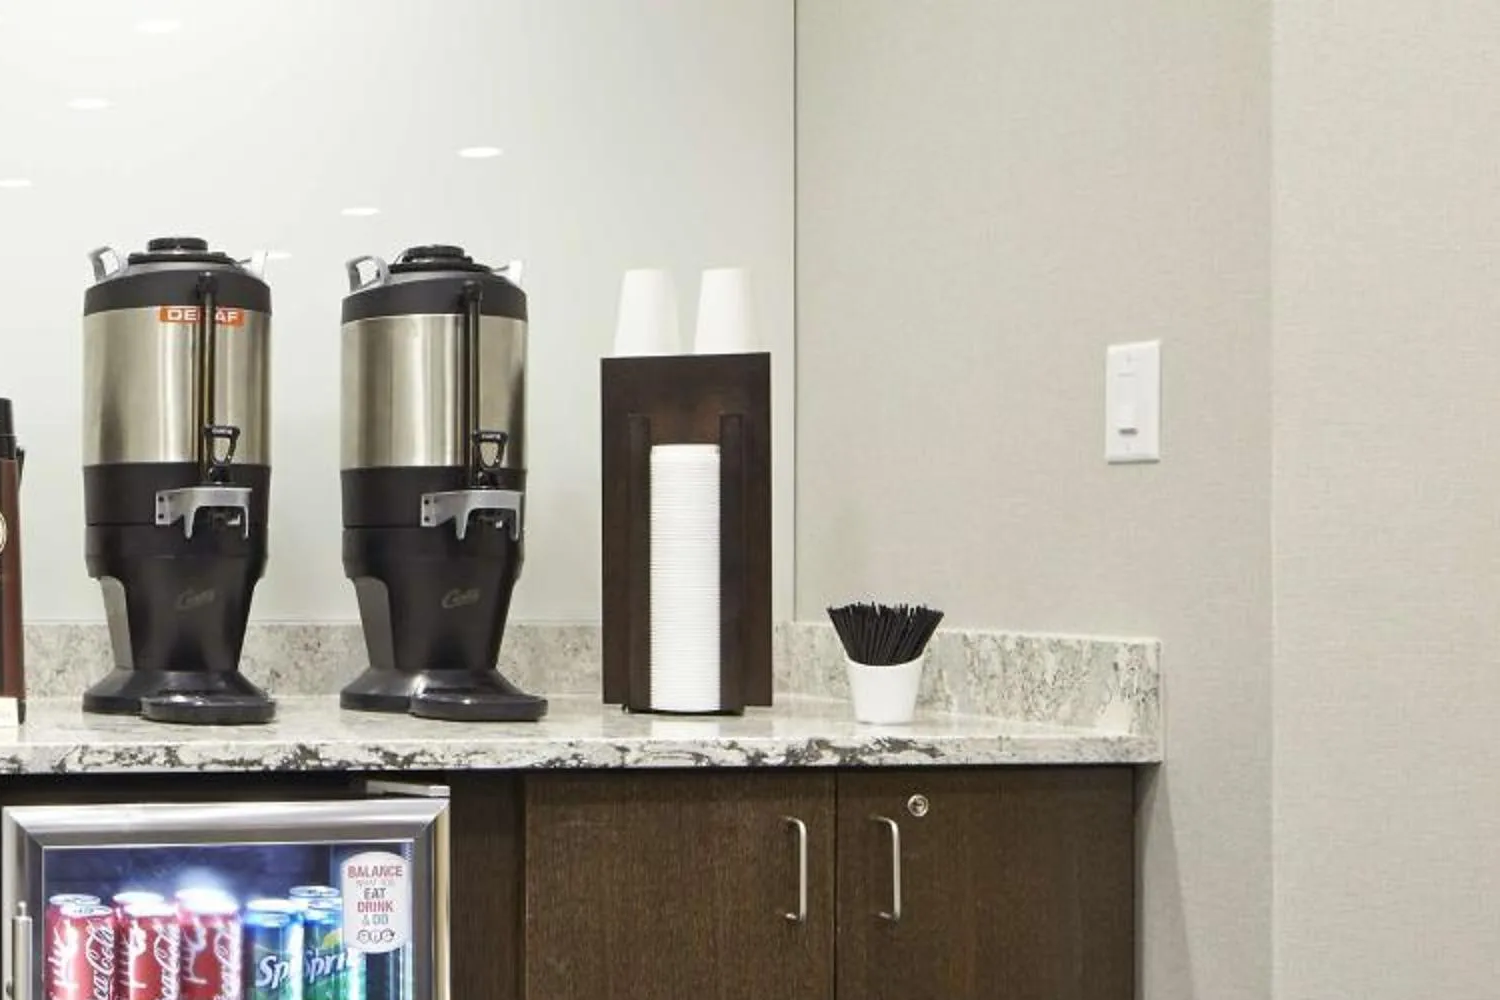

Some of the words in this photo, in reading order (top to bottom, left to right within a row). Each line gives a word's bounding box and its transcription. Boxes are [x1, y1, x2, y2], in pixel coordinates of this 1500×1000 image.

[167, 308, 238, 323] DEAF
[347, 865, 404, 879] BALANCE
[364, 887, 387, 900] EAT
[357, 901, 394, 914] DRINK
